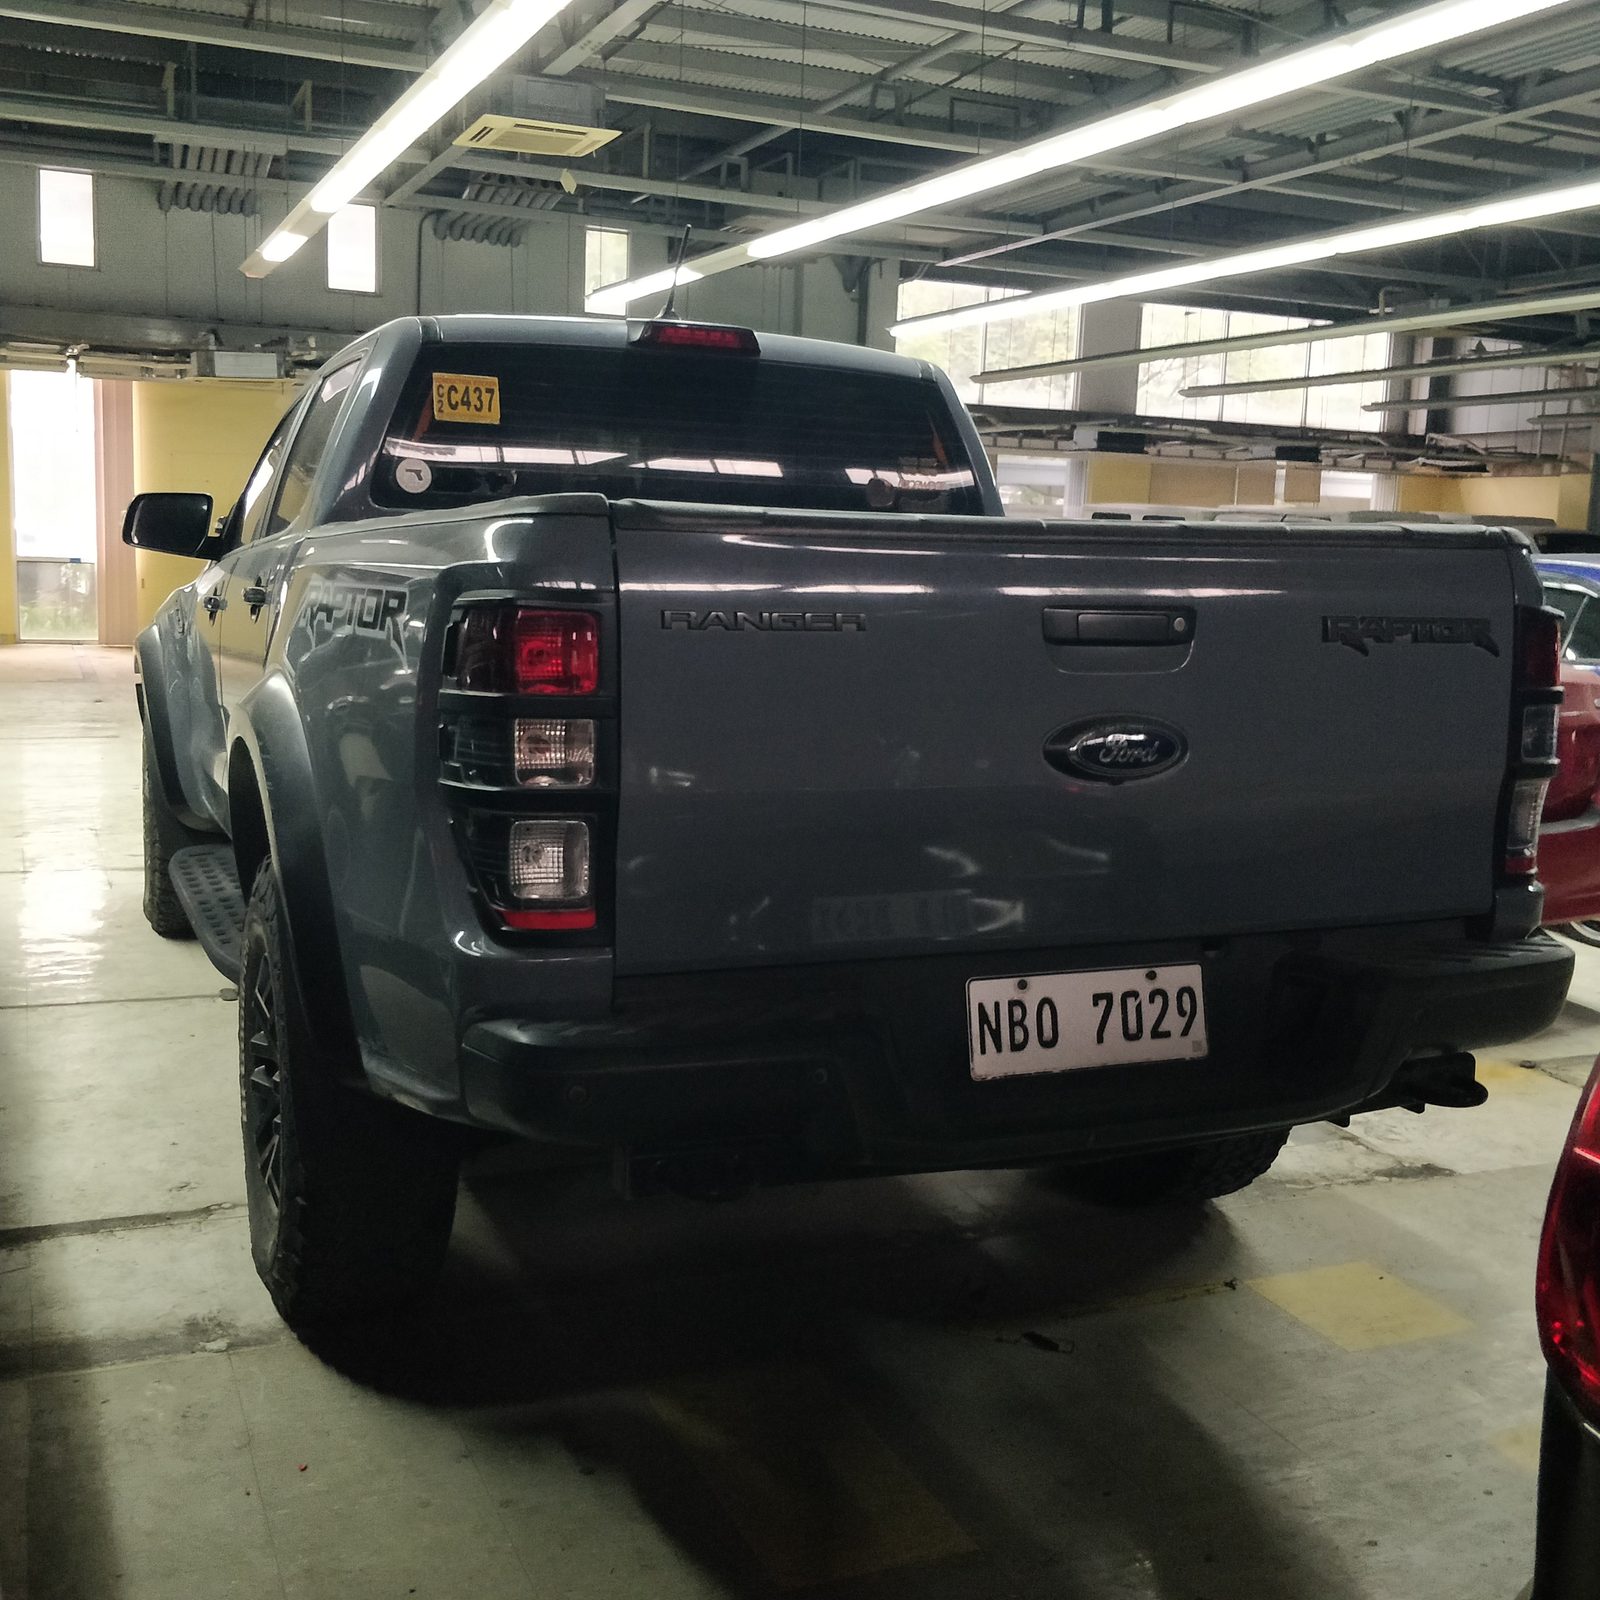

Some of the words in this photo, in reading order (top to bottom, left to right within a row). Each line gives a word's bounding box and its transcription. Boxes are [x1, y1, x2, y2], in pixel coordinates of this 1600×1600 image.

[447, 385, 495, 412] C437
[299, 577, 410, 673] RAPTOR
[661, 610, 867, 632] RANGER
[1322, 616, 1500, 657] RAPTOR
[1099, 738, 1160, 763] Ford
[978, 997, 1059, 1055] NBO
[1092, 986, 1198, 1044] 7029
